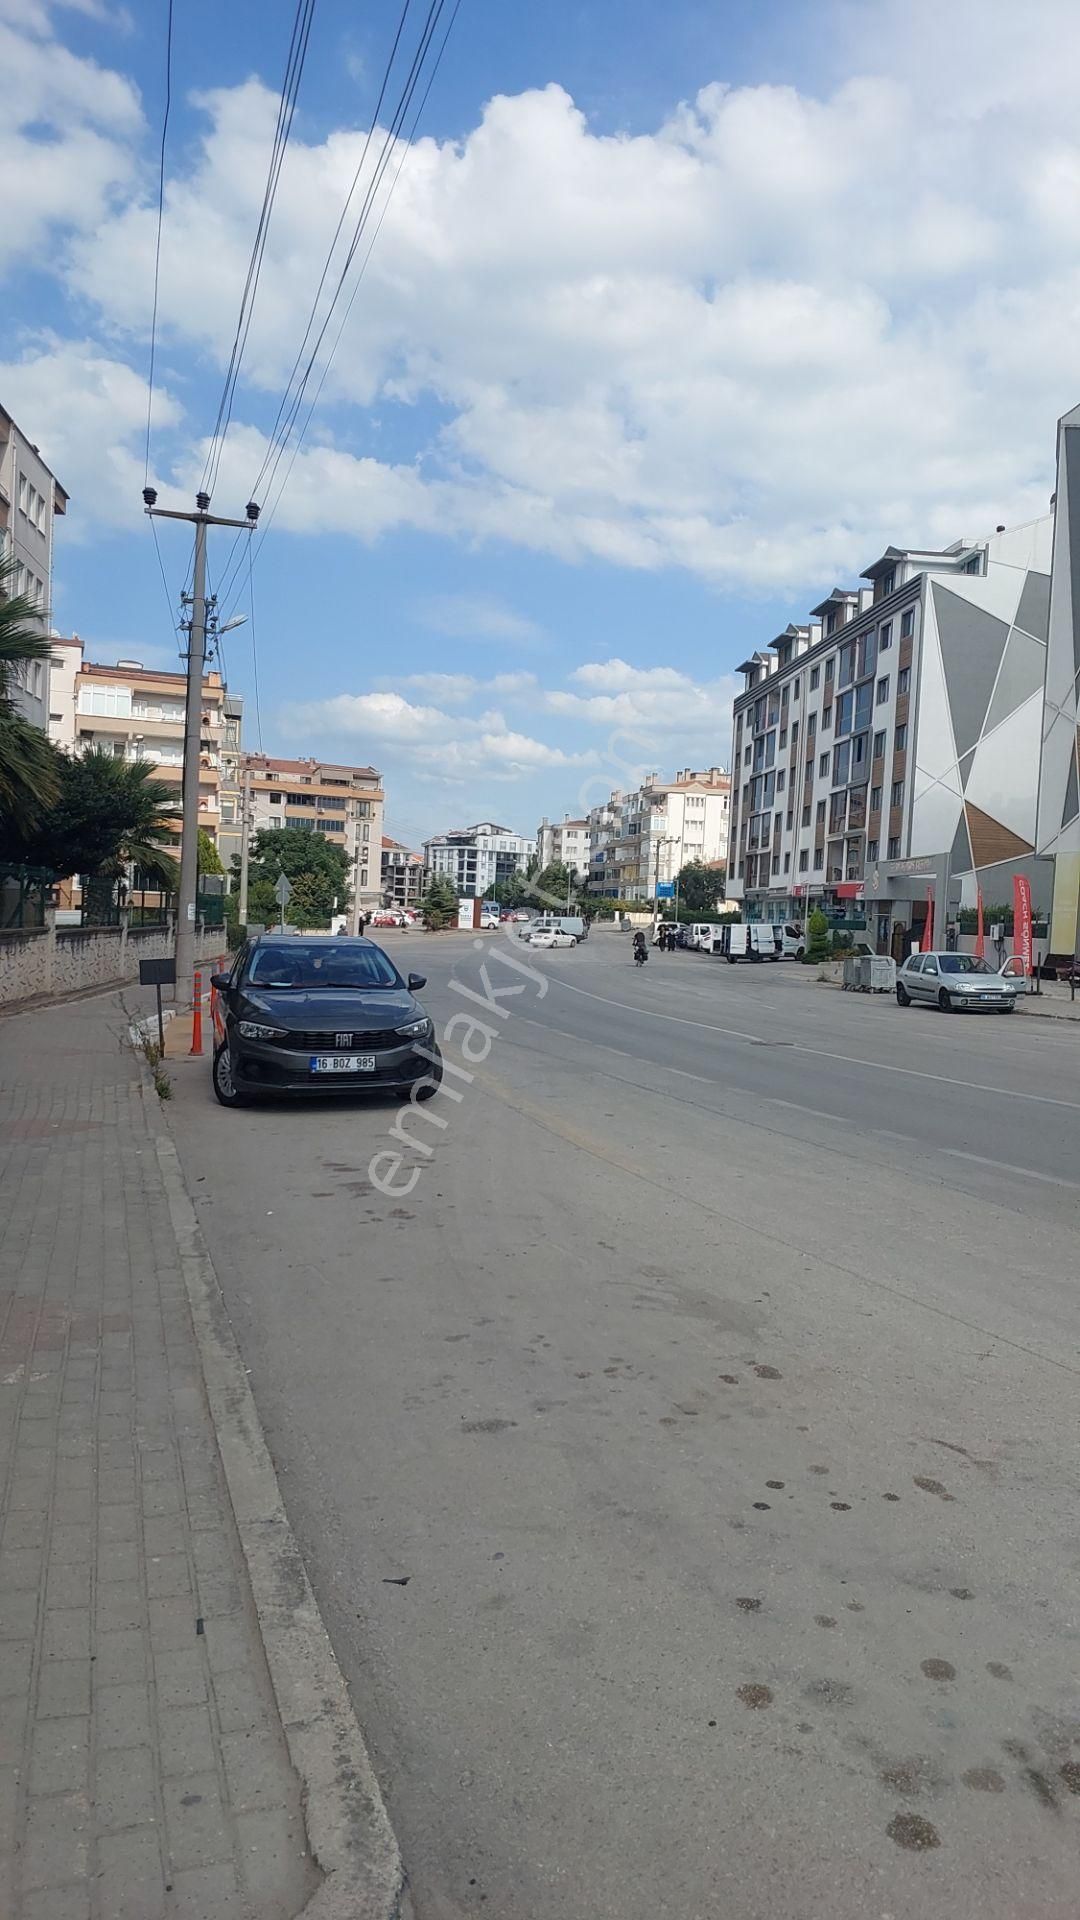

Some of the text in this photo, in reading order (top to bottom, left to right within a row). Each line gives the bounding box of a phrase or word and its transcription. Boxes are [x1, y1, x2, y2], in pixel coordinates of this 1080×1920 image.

[335, 1033, 354, 1047] FIAT
[318, 1058, 328, 1069] 16
[356, 1057, 374, 1068] 985
